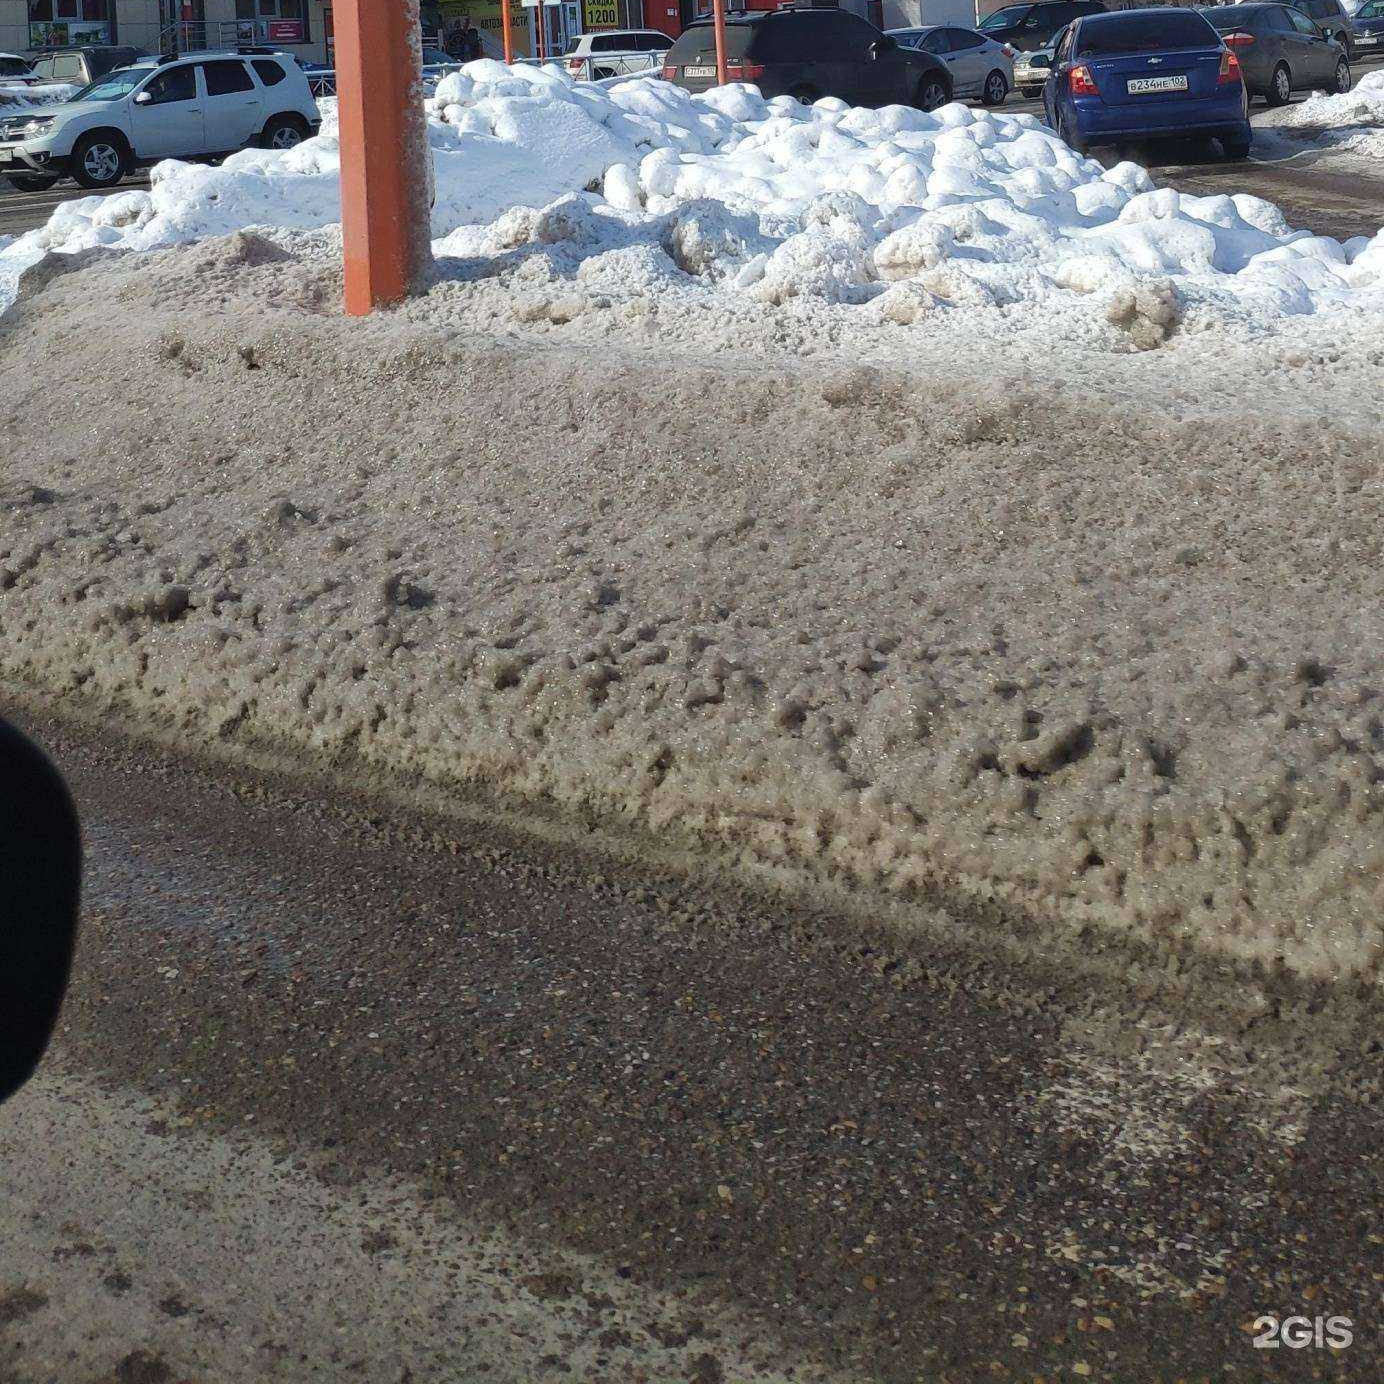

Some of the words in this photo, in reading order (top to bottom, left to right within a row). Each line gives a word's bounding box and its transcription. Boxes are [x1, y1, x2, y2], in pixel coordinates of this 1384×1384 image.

[588, 9, 616, 24] 1200
[1130, 78, 1169, 91] В234НЕ
[1170, 76, 1185, 86] 102
